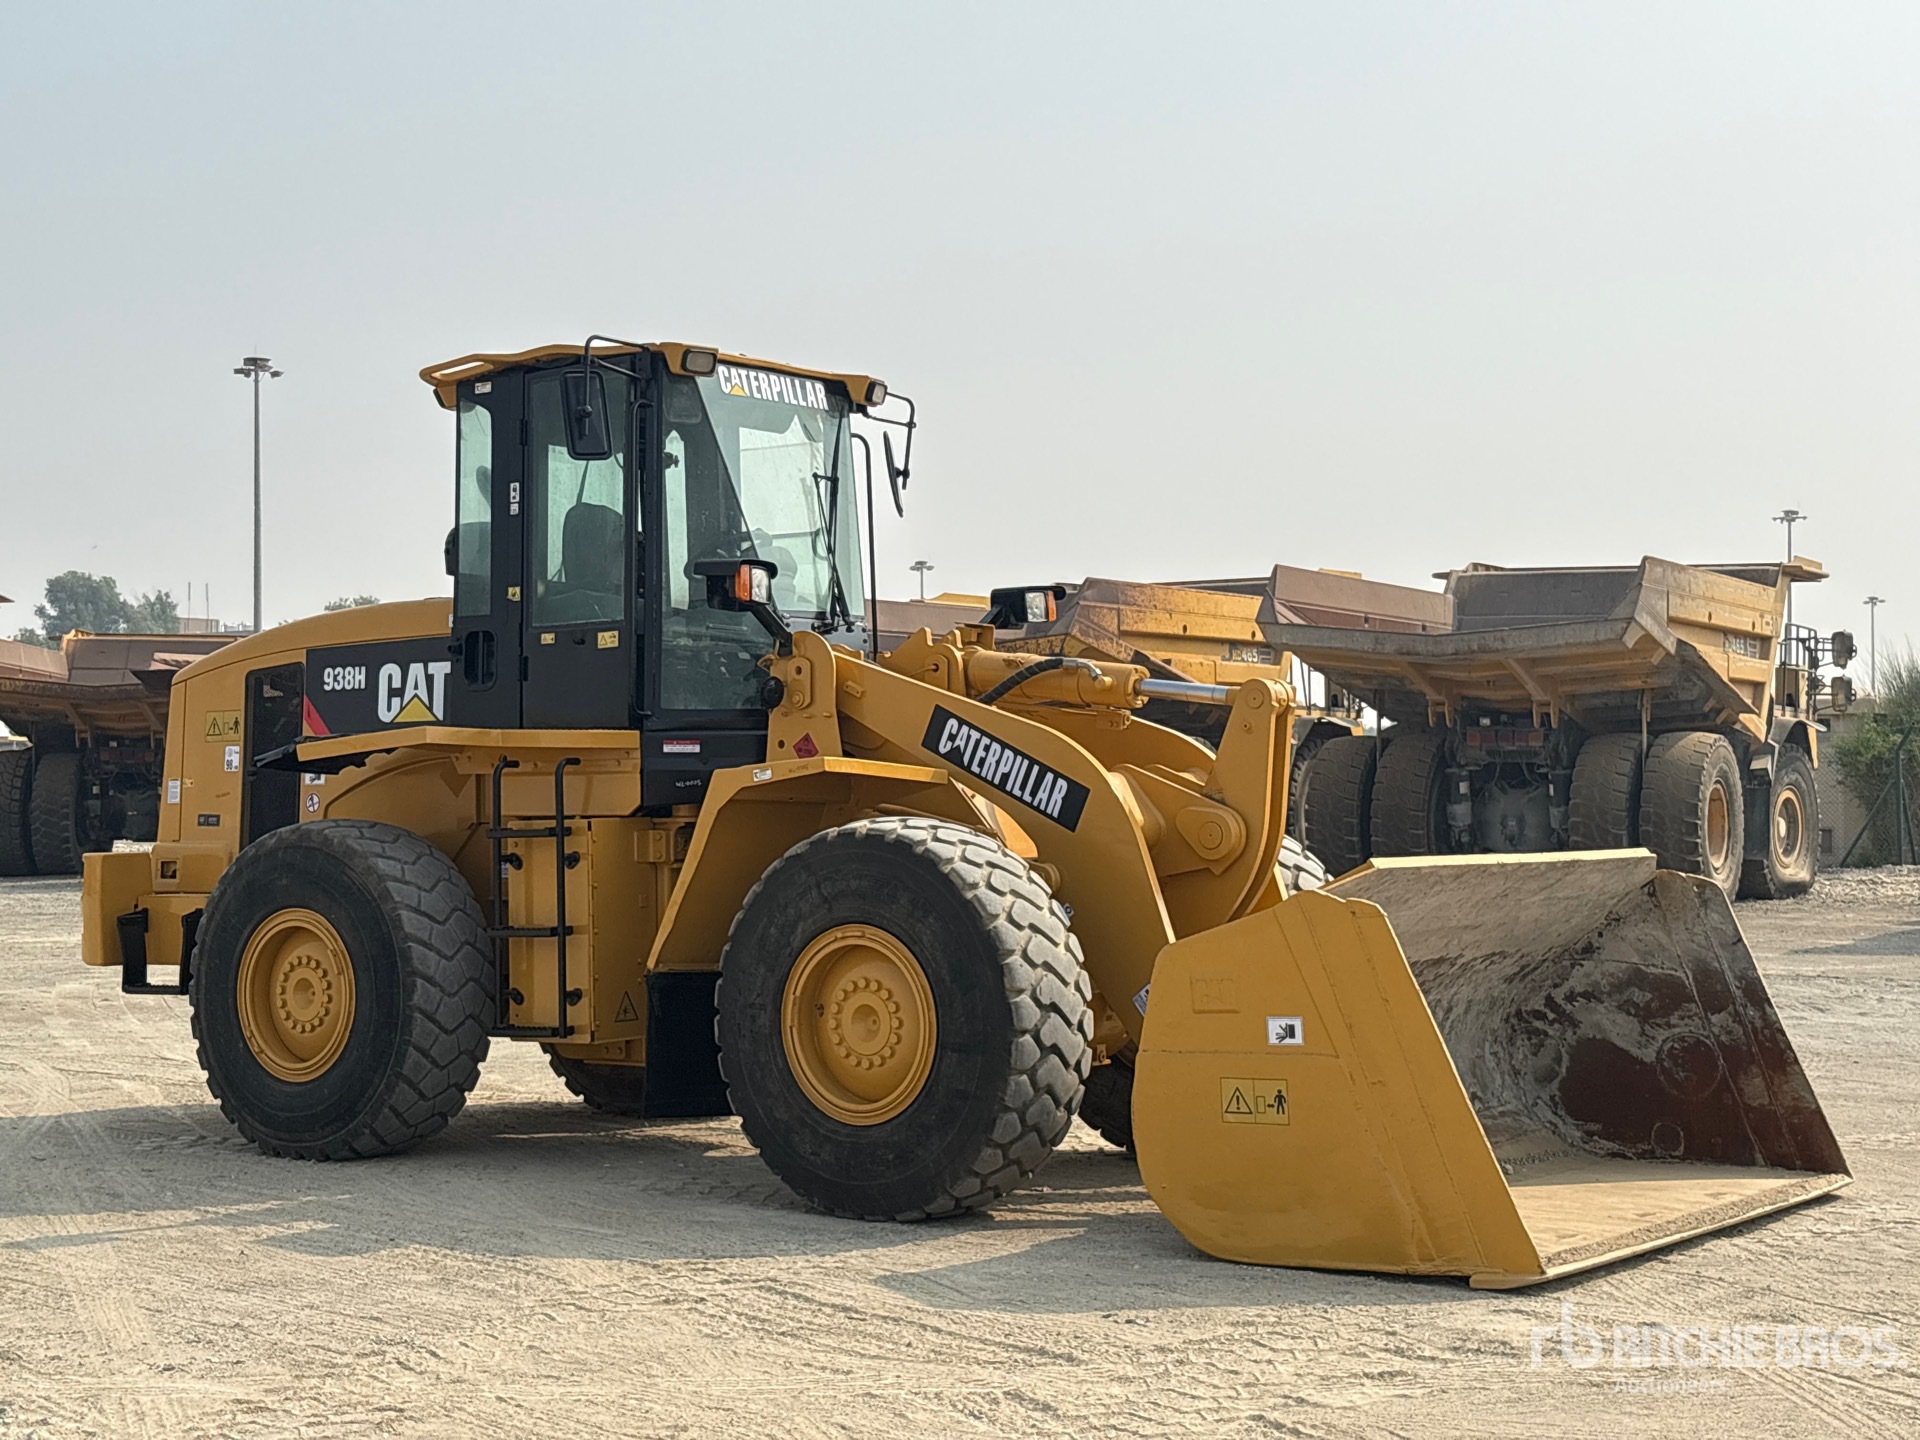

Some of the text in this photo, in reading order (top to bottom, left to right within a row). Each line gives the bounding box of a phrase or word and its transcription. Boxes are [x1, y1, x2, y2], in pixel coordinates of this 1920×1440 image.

[717, 365, 829, 411] CATERPILLAR
[323, 666, 366, 691] 938H
[377, 661, 451, 723] CAT
[938, 717, 1068, 819] CATERPILLAR
